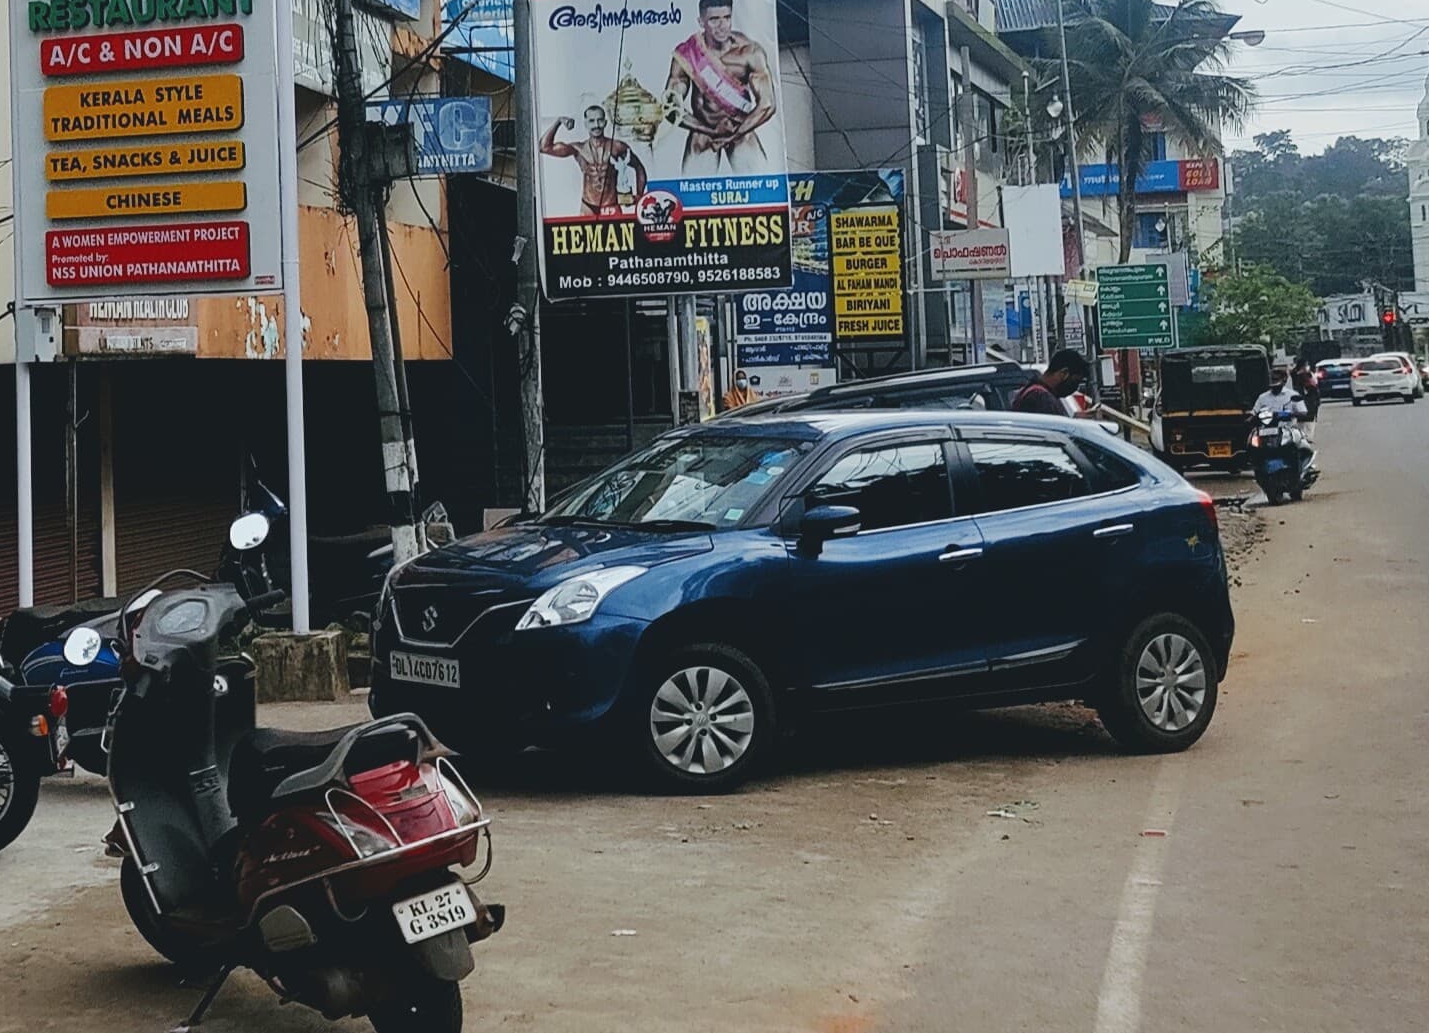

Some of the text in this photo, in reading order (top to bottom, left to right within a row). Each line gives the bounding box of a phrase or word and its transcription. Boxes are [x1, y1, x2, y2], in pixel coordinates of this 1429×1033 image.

[49, 30, 234, 68] A/C & NON A/C
[80, 84, 203, 108] KERALA STYLE
[51, 105, 234, 134] TRADITIONAL MEALS
[50, 146, 237, 174] TEA, SNACKS & JUICE
[679, 180, 723, 193] Masters
[725, 178, 763, 191] Runner
[765, 179, 780, 192] up
[105, 190, 182, 209] CHINESE
[710, 191, 750, 205] SURAJ
[643, 223, 677, 232] HEMAN
[684, 215, 784, 249] FITNESS
[835, 215, 893, 229] SHAWARMA
[52, 226, 240, 249] A WOMEN EMPOWERMENT PROJECT
[552, 222, 635, 256] HEMAN
[835, 235, 896, 249] BAR BE QUE
[52, 252, 109, 264] Promoted by:
[608, 251, 729, 270] Pathanamthitta
[846, 257, 888, 271] BURGER
[52, 259, 240, 280] NSS UNION PATHANAMTHITTA
[559, 274, 593, 289] Mob
[607, 270, 694, 286] 9446508790,
[698, 267, 781, 283] 9526188583
[837, 277, 898, 290] AL FAHAM MANDI
[742, 291, 827, 312] അക്ഷയ
[846, 298, 891, 312] BIRIYANI
[838, 319, 900, 332] FRESH JUICE
[408, 891, 452, 918] KL 27
[409, 904, 467, 936] G 3819
